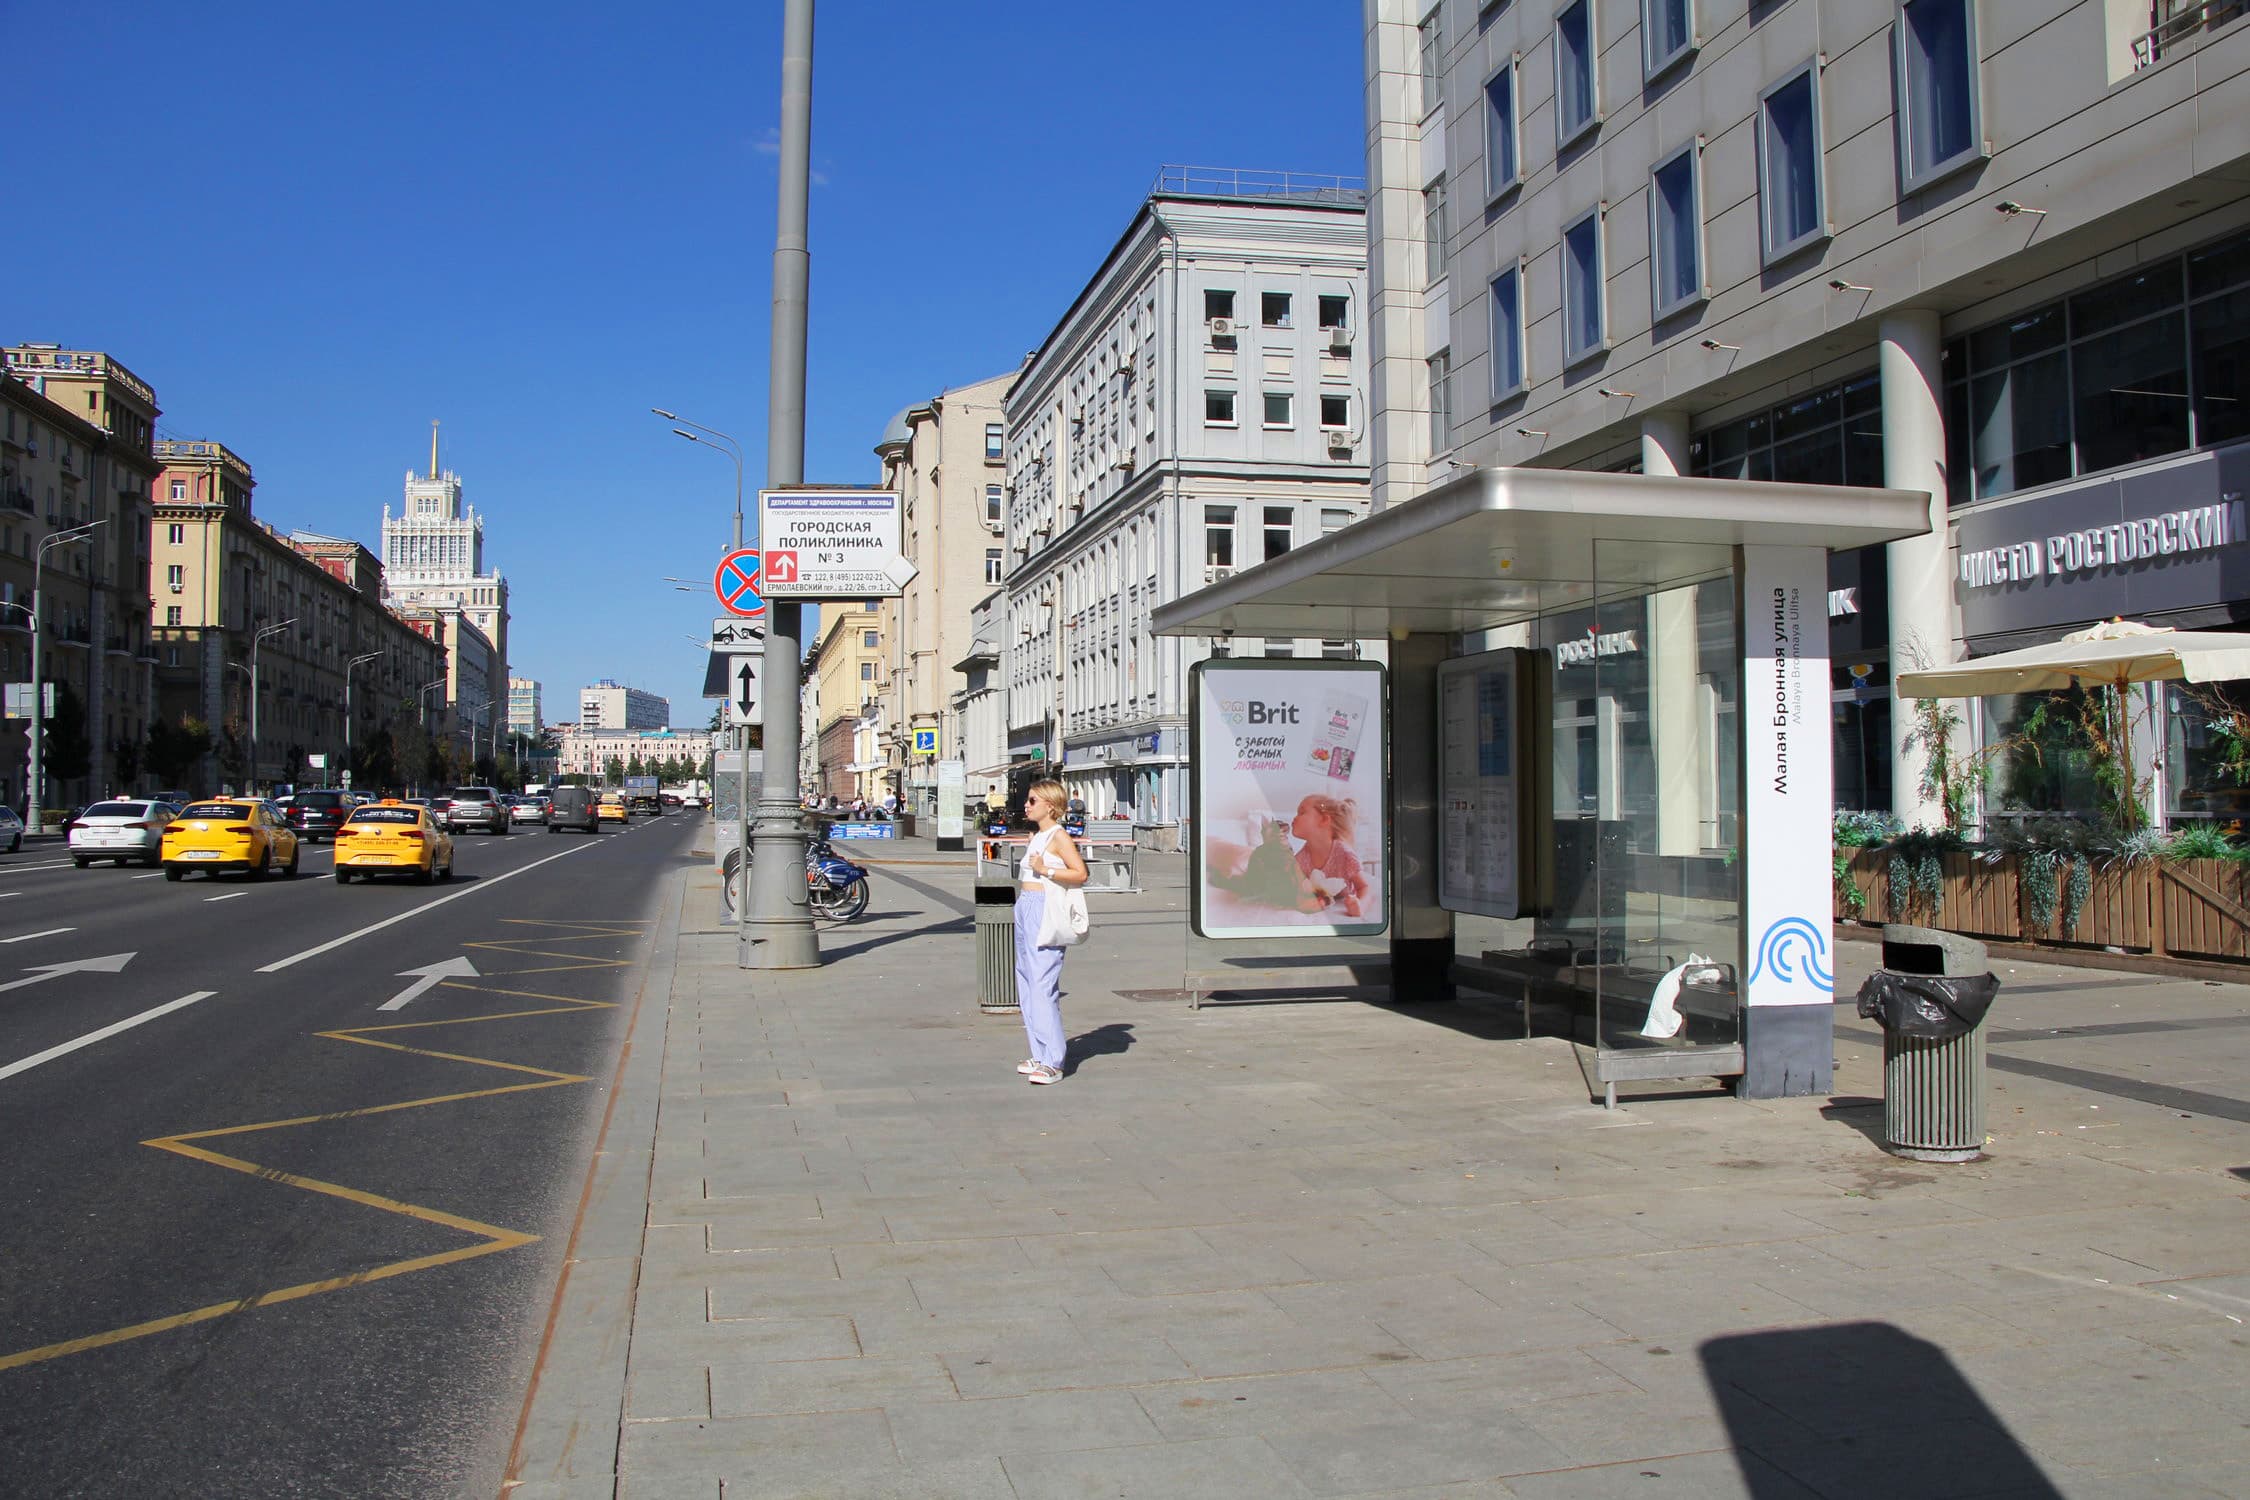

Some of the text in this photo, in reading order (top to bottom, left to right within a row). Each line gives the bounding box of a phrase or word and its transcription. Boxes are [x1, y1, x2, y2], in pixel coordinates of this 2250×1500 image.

[790, 521, 872, 534] ГОРОДСКАЯ
[779, 537, 883, 548] ПОЛИКЛИНИКА
[1960, 493, 2248, 588] ЧИСТО РОСТОВСКИЙ
[835, 552, 844, 563] 3
[852, 572, 883, 581] 122-02-21
[767, 583, 822, 591] ЕРМОЛАЕВСКИЙ
[1789, 587, 1802, 724] Malaya Bronnaya Ulitsa
[1774, 587, 1788, 795] Малая Бронная улица
[1248, 701, 1300, 724] Brit
[1243, 735, 1286, 749] ЗАБОТОЙ
[1247, 748, 1283, 759] САМЫХ
[1233, 760, 1287, 770] ЛЮБИМЫХ
